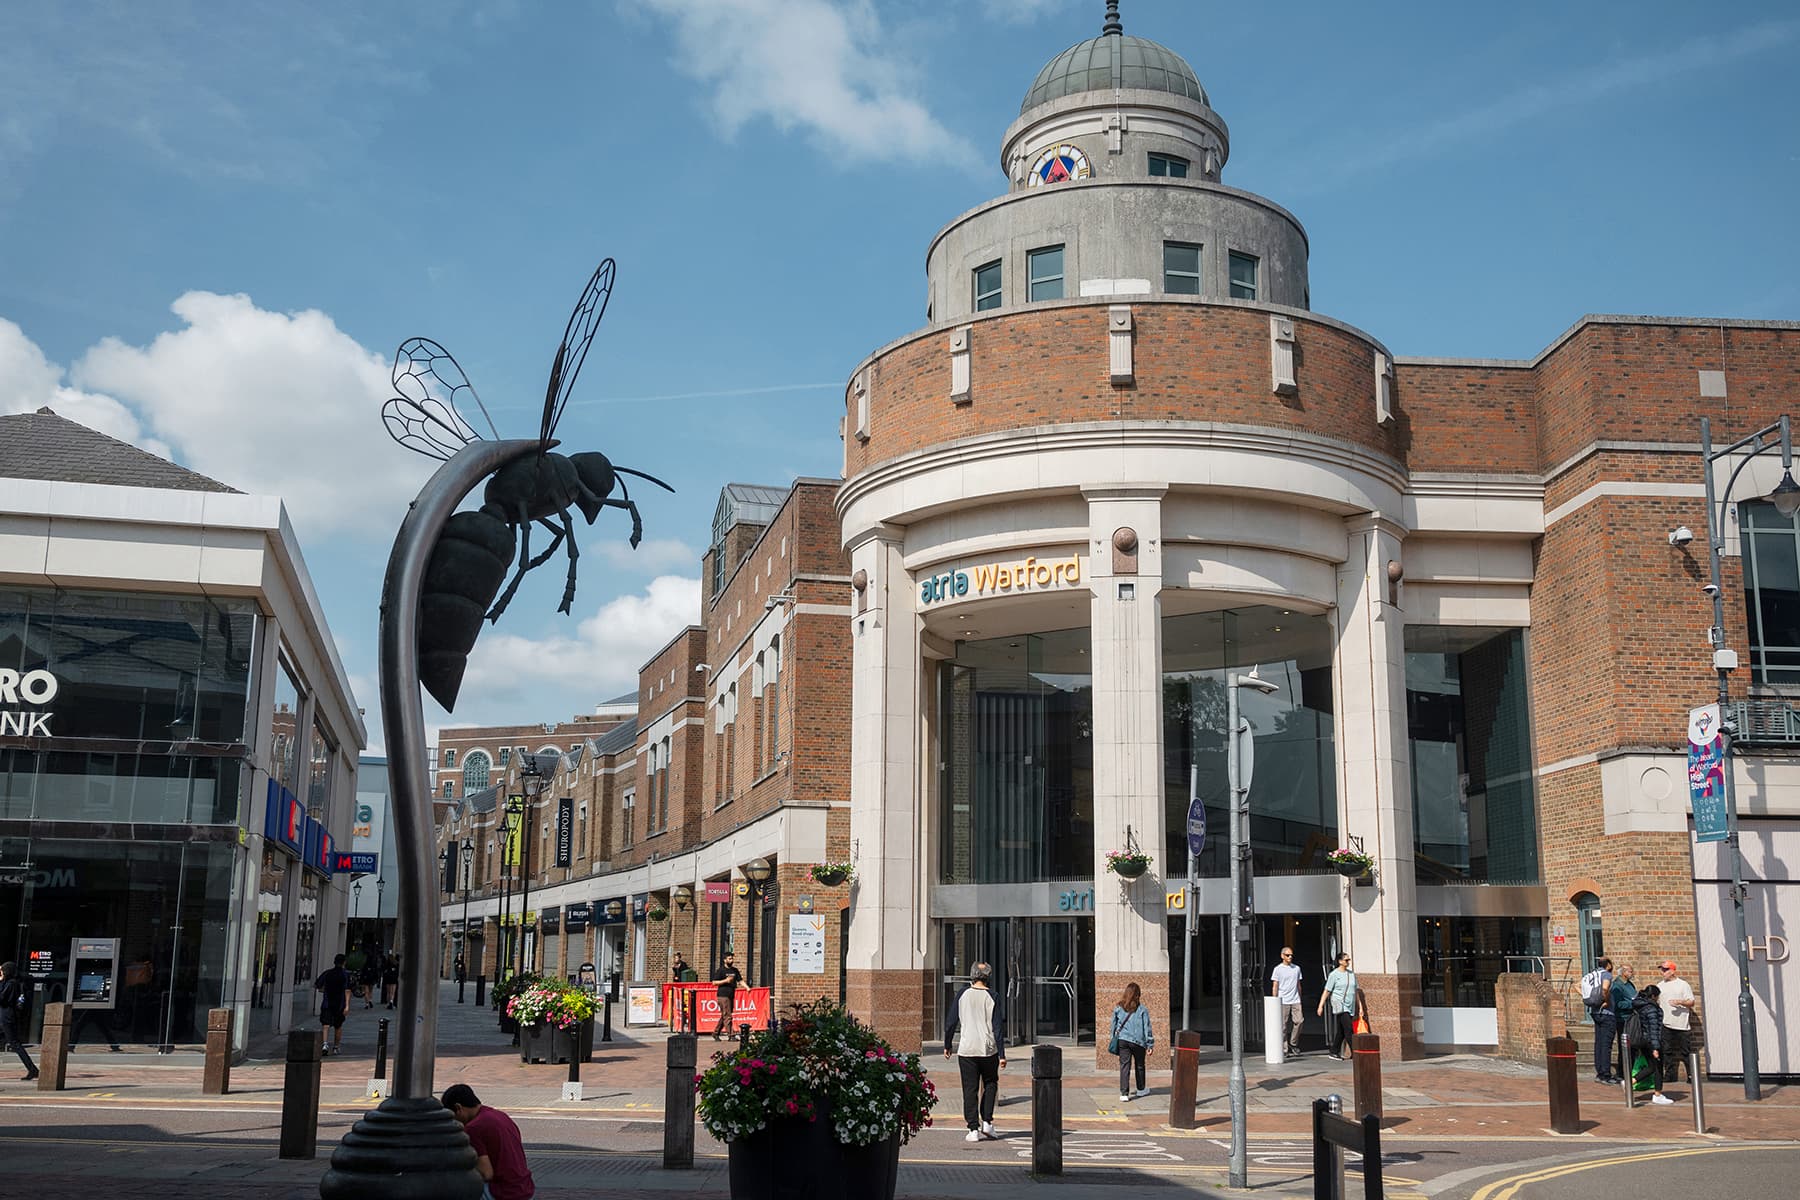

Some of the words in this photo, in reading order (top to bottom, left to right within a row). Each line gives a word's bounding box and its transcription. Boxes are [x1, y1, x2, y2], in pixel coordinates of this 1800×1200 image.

[921, 570, 968, 603] atria
[973, 552, 1080, 592] Watford
[1690, 772, 1705, 782] High
[1690, 781, 1710, 790] Street
[560, 805, 570, 862] SHUROPODY
[338, 854, 374, 869] METRO
[1746, 935, 1789, 961] HD
[701, 999, 757, 1012] TOLLA
